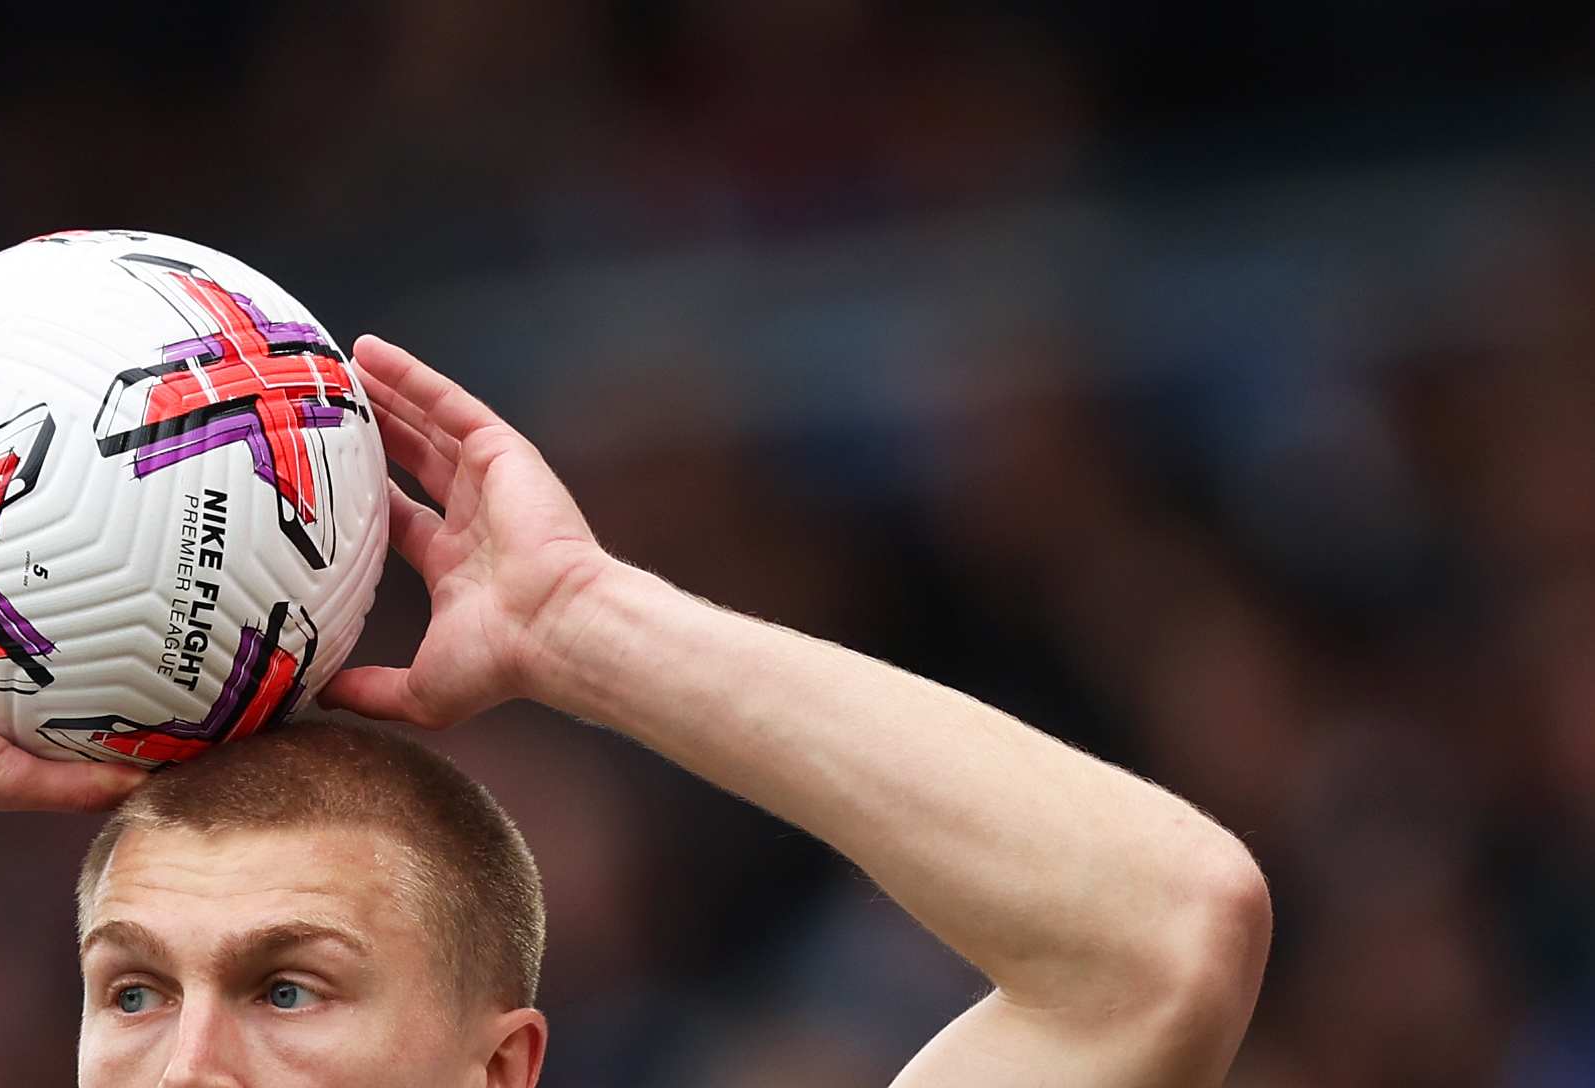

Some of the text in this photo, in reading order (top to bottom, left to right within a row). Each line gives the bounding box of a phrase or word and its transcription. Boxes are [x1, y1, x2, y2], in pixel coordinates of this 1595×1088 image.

[32, 563, 49, 580] 5
[157, 494, 200, 677] PREMIER LEAGUE
[173, 488, 228, 692] NIKE FLIGHT
